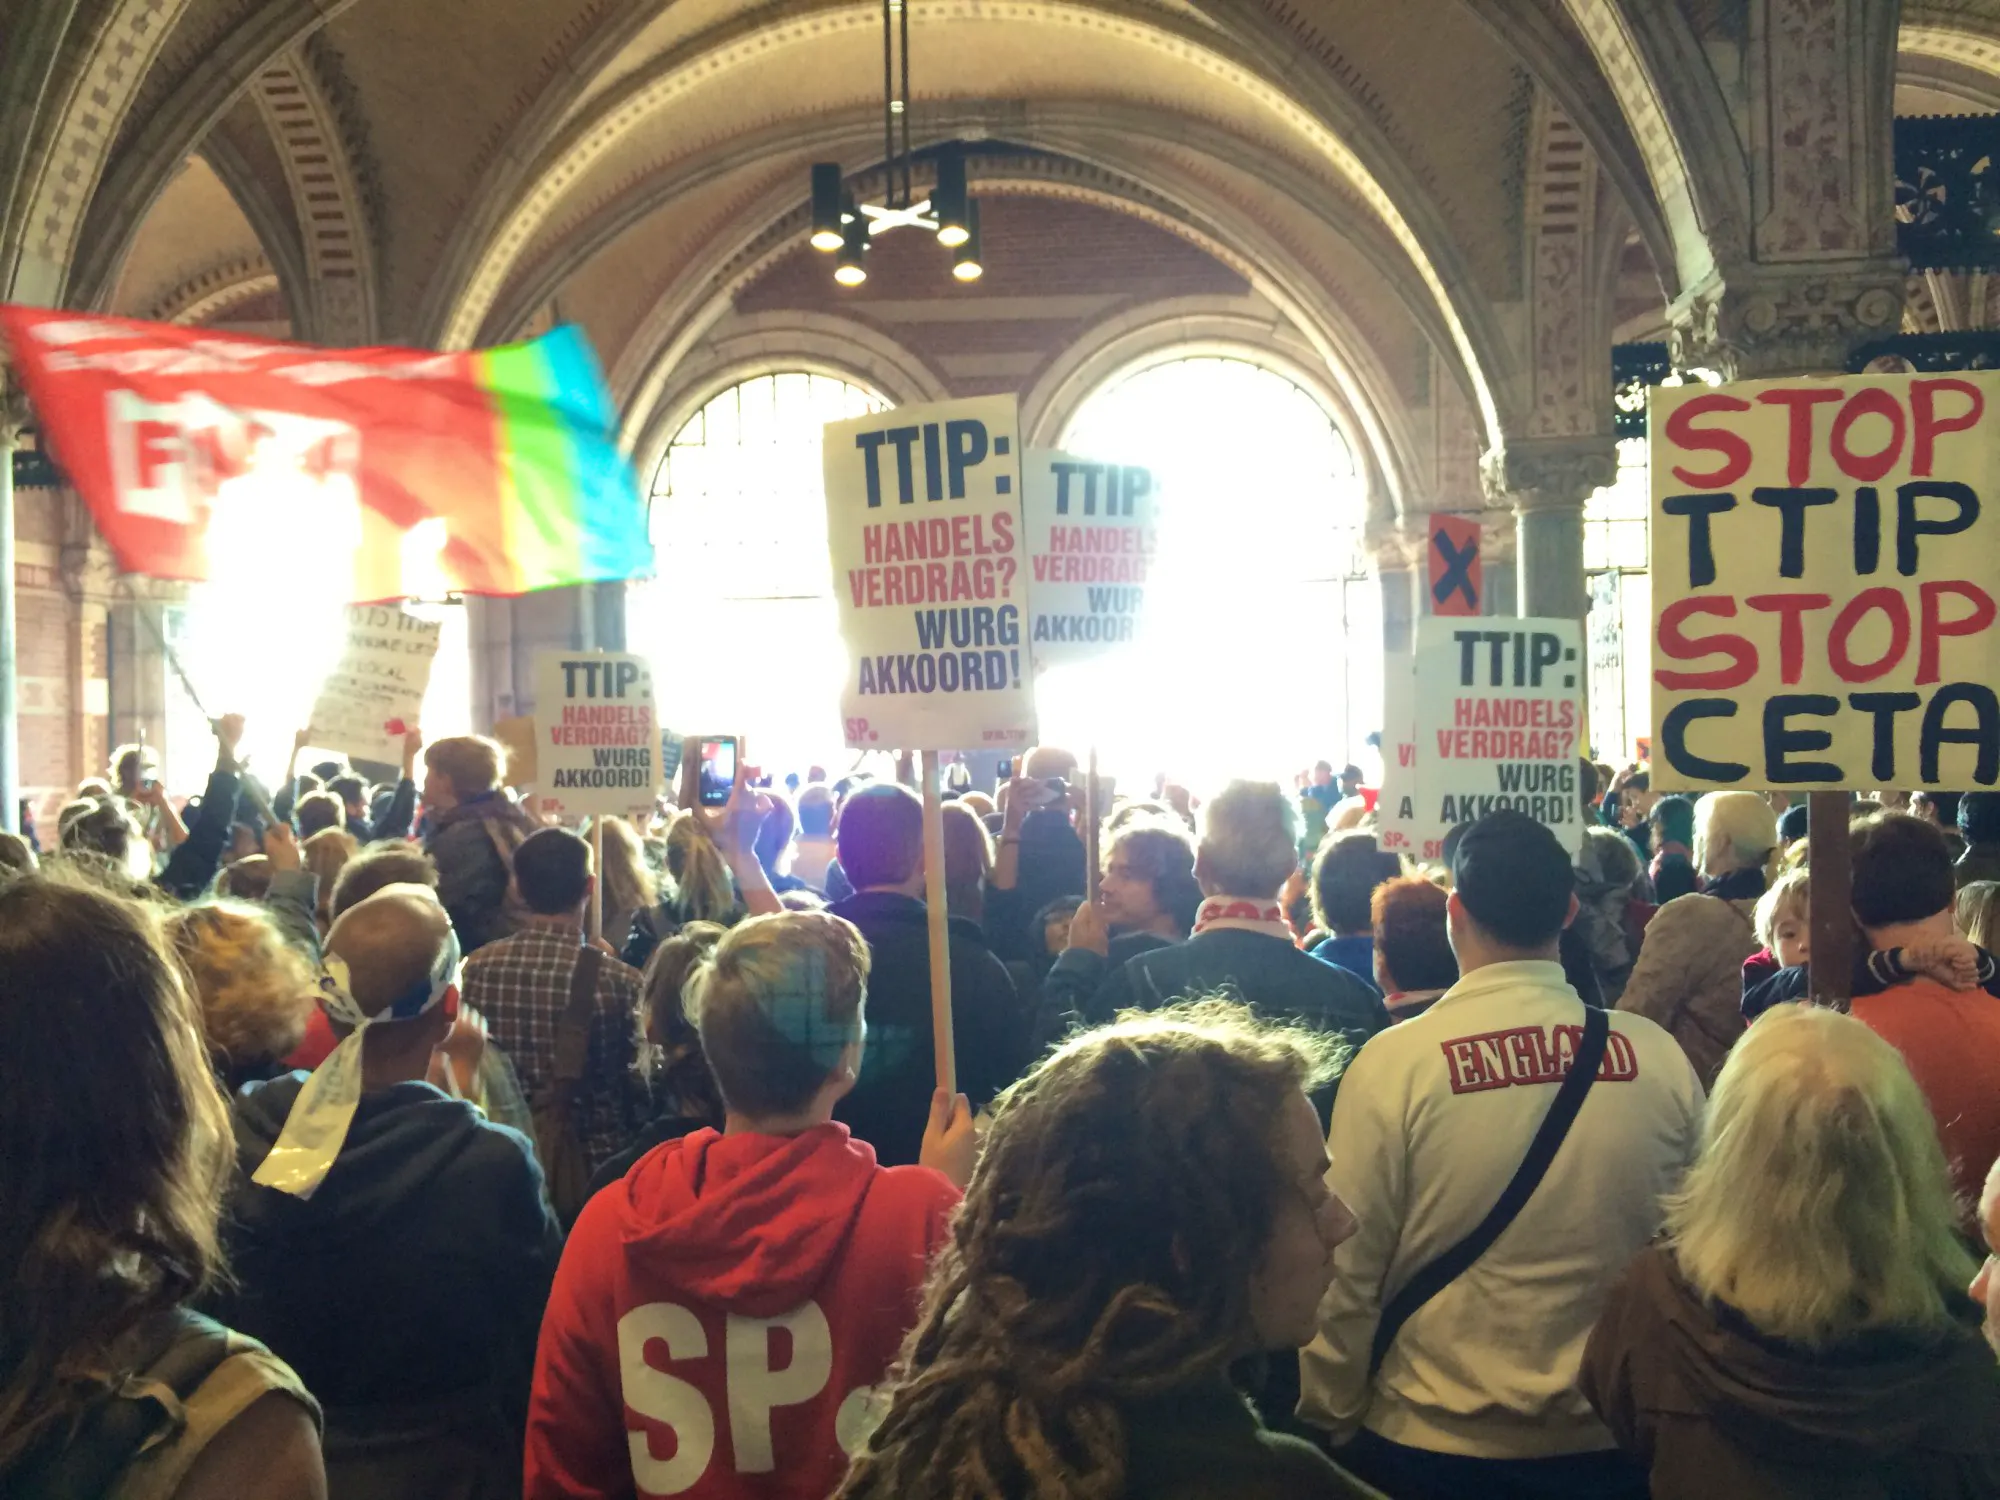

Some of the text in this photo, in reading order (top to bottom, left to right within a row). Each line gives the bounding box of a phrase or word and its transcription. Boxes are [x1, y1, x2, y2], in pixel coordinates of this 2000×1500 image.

[1665, 378, 1985, 488] STOP
[856, 418, 1011, 508] TTIP:
[863, 511, 1015, 564] HANDELS
[1661, 481, 1981, 588] TTIP
[848, 556, 1017, 608] VERDRAG?
[1087, 586, 1144, 613] WUR
[915, 603, 1019, 649] WURG
[1654, 580, 1997, 691] STOP
[561, 661, 650, 698] TTIP:
[858, 650, 1021, 695] AKKOORD!
[1454, 631, 1575, 688] TTIP:
[551, 727, 650, 746] VERDRAG?
[563, 705, 650, 725] HANDELS
[1455, 699, 1574, 729] HANDELS
[1661, 682, 1999, 785] CETA
[593, 748, 650, 767] WURG
[1437, 730, 1574, 759] VERDRAG?
[554, 769, 650, 788] AKKOORD!
[1497, 764, 1574, 793] WURG
[1449, 1030, 1632, 1087] ENGLAD
